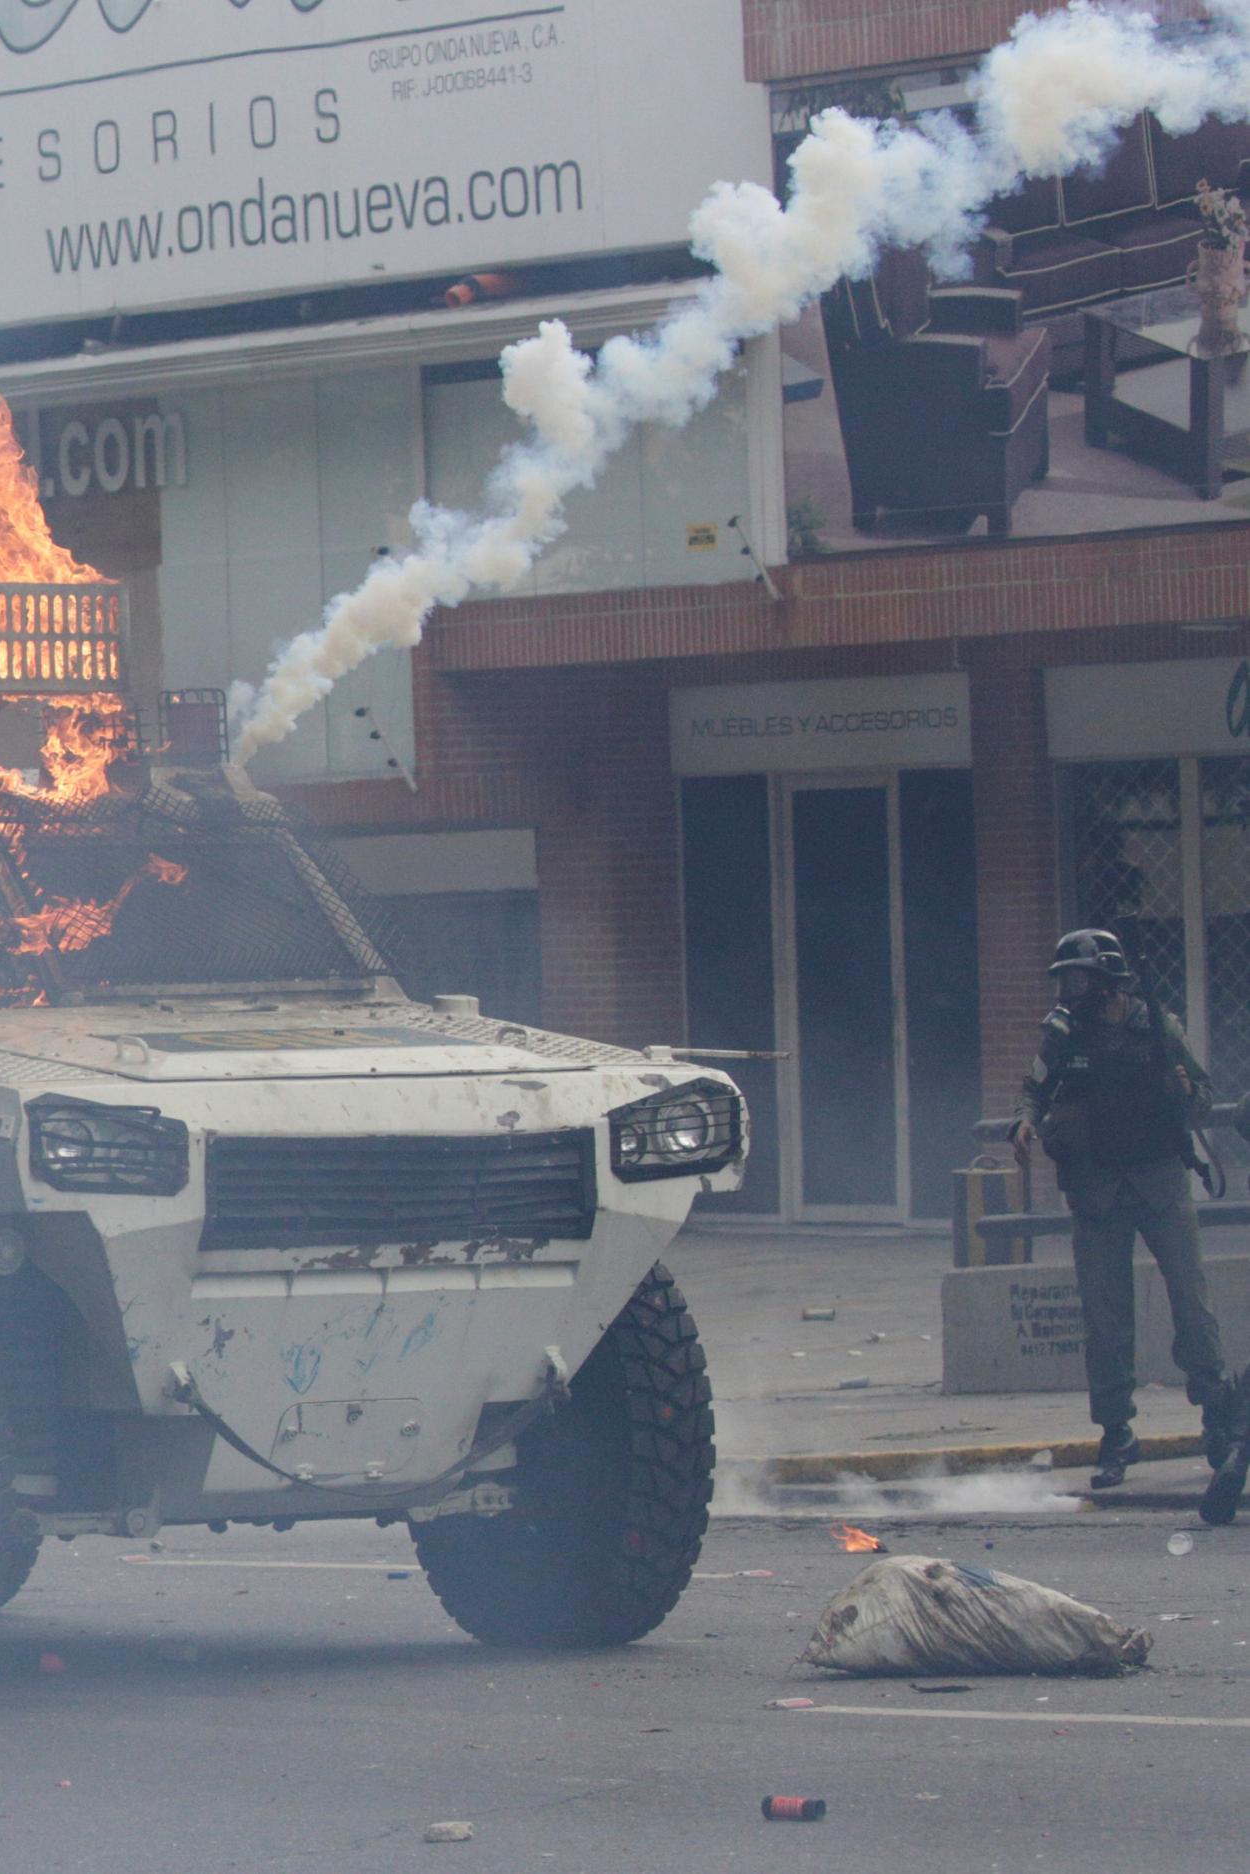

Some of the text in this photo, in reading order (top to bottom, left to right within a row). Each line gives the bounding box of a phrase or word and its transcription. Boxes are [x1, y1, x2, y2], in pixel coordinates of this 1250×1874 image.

[368, 43, 420, 73] GRUPO
[425, 38, 469, 65] ONDA
[422, 61, 533, 98] J-00068441-3
[47, 158, 584, 276] www.ondanueva.com
[29, 406, 187, 498] .com
[691, 706, 959, 739] MUEBLES Y ACCESORIOS
